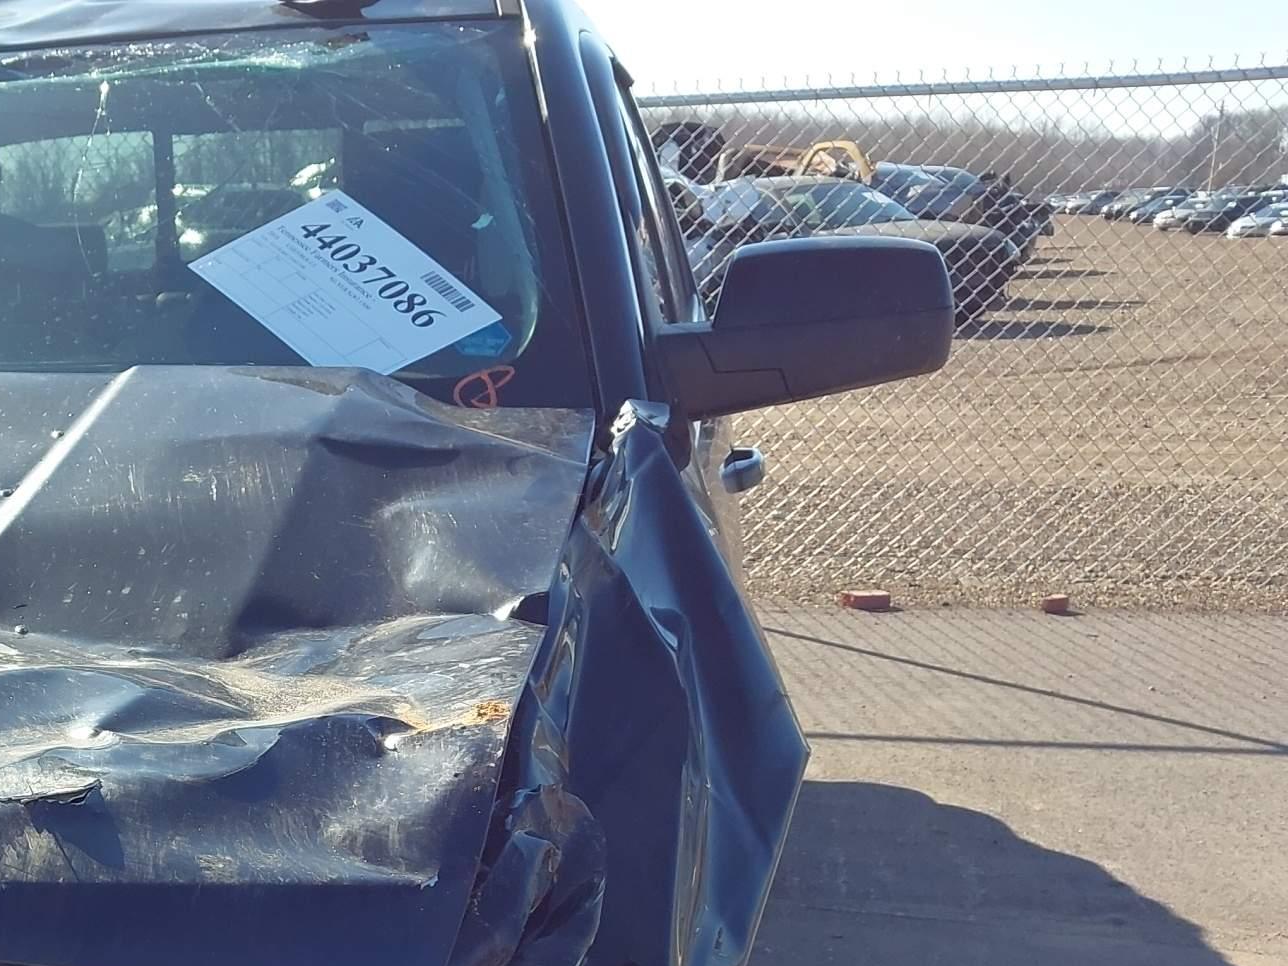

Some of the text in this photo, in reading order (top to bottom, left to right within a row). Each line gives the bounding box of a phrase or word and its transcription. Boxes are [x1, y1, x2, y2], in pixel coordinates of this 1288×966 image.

[300, 223, 445, 328] 44037086
[310, 249, 339, 273] Farmers
[337, 270, 373, 299] Insurance
